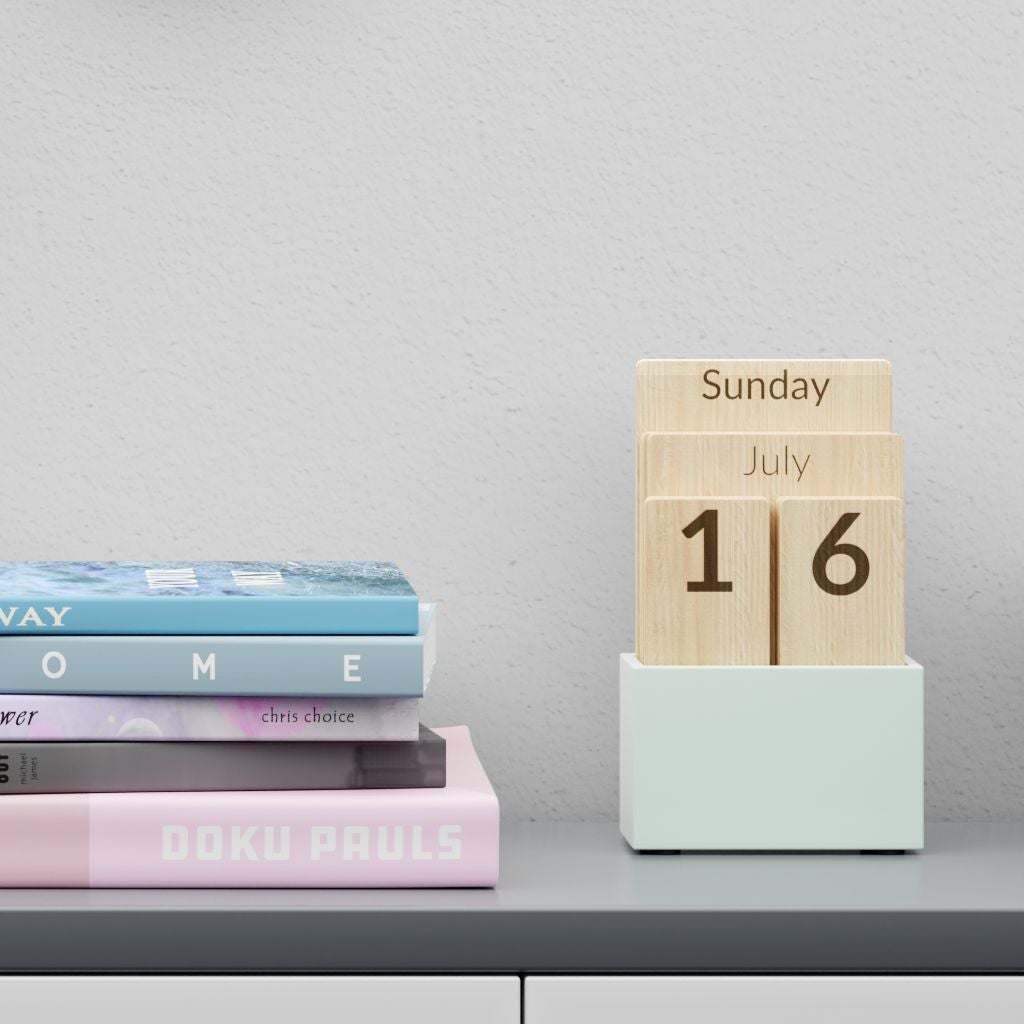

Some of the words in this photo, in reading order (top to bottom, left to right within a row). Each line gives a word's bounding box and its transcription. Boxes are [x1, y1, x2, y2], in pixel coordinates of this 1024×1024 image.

[702, 368, 831, 407] Sunday
[743, 446, 812, 483] July
[261, 706, 298, 724] chris
[304, 706, 355, 724] choice
[19, 752, 28, 785] michael
[161, 824, 291, 861] DOKU
[310, 824, 464, 861] PAULS
